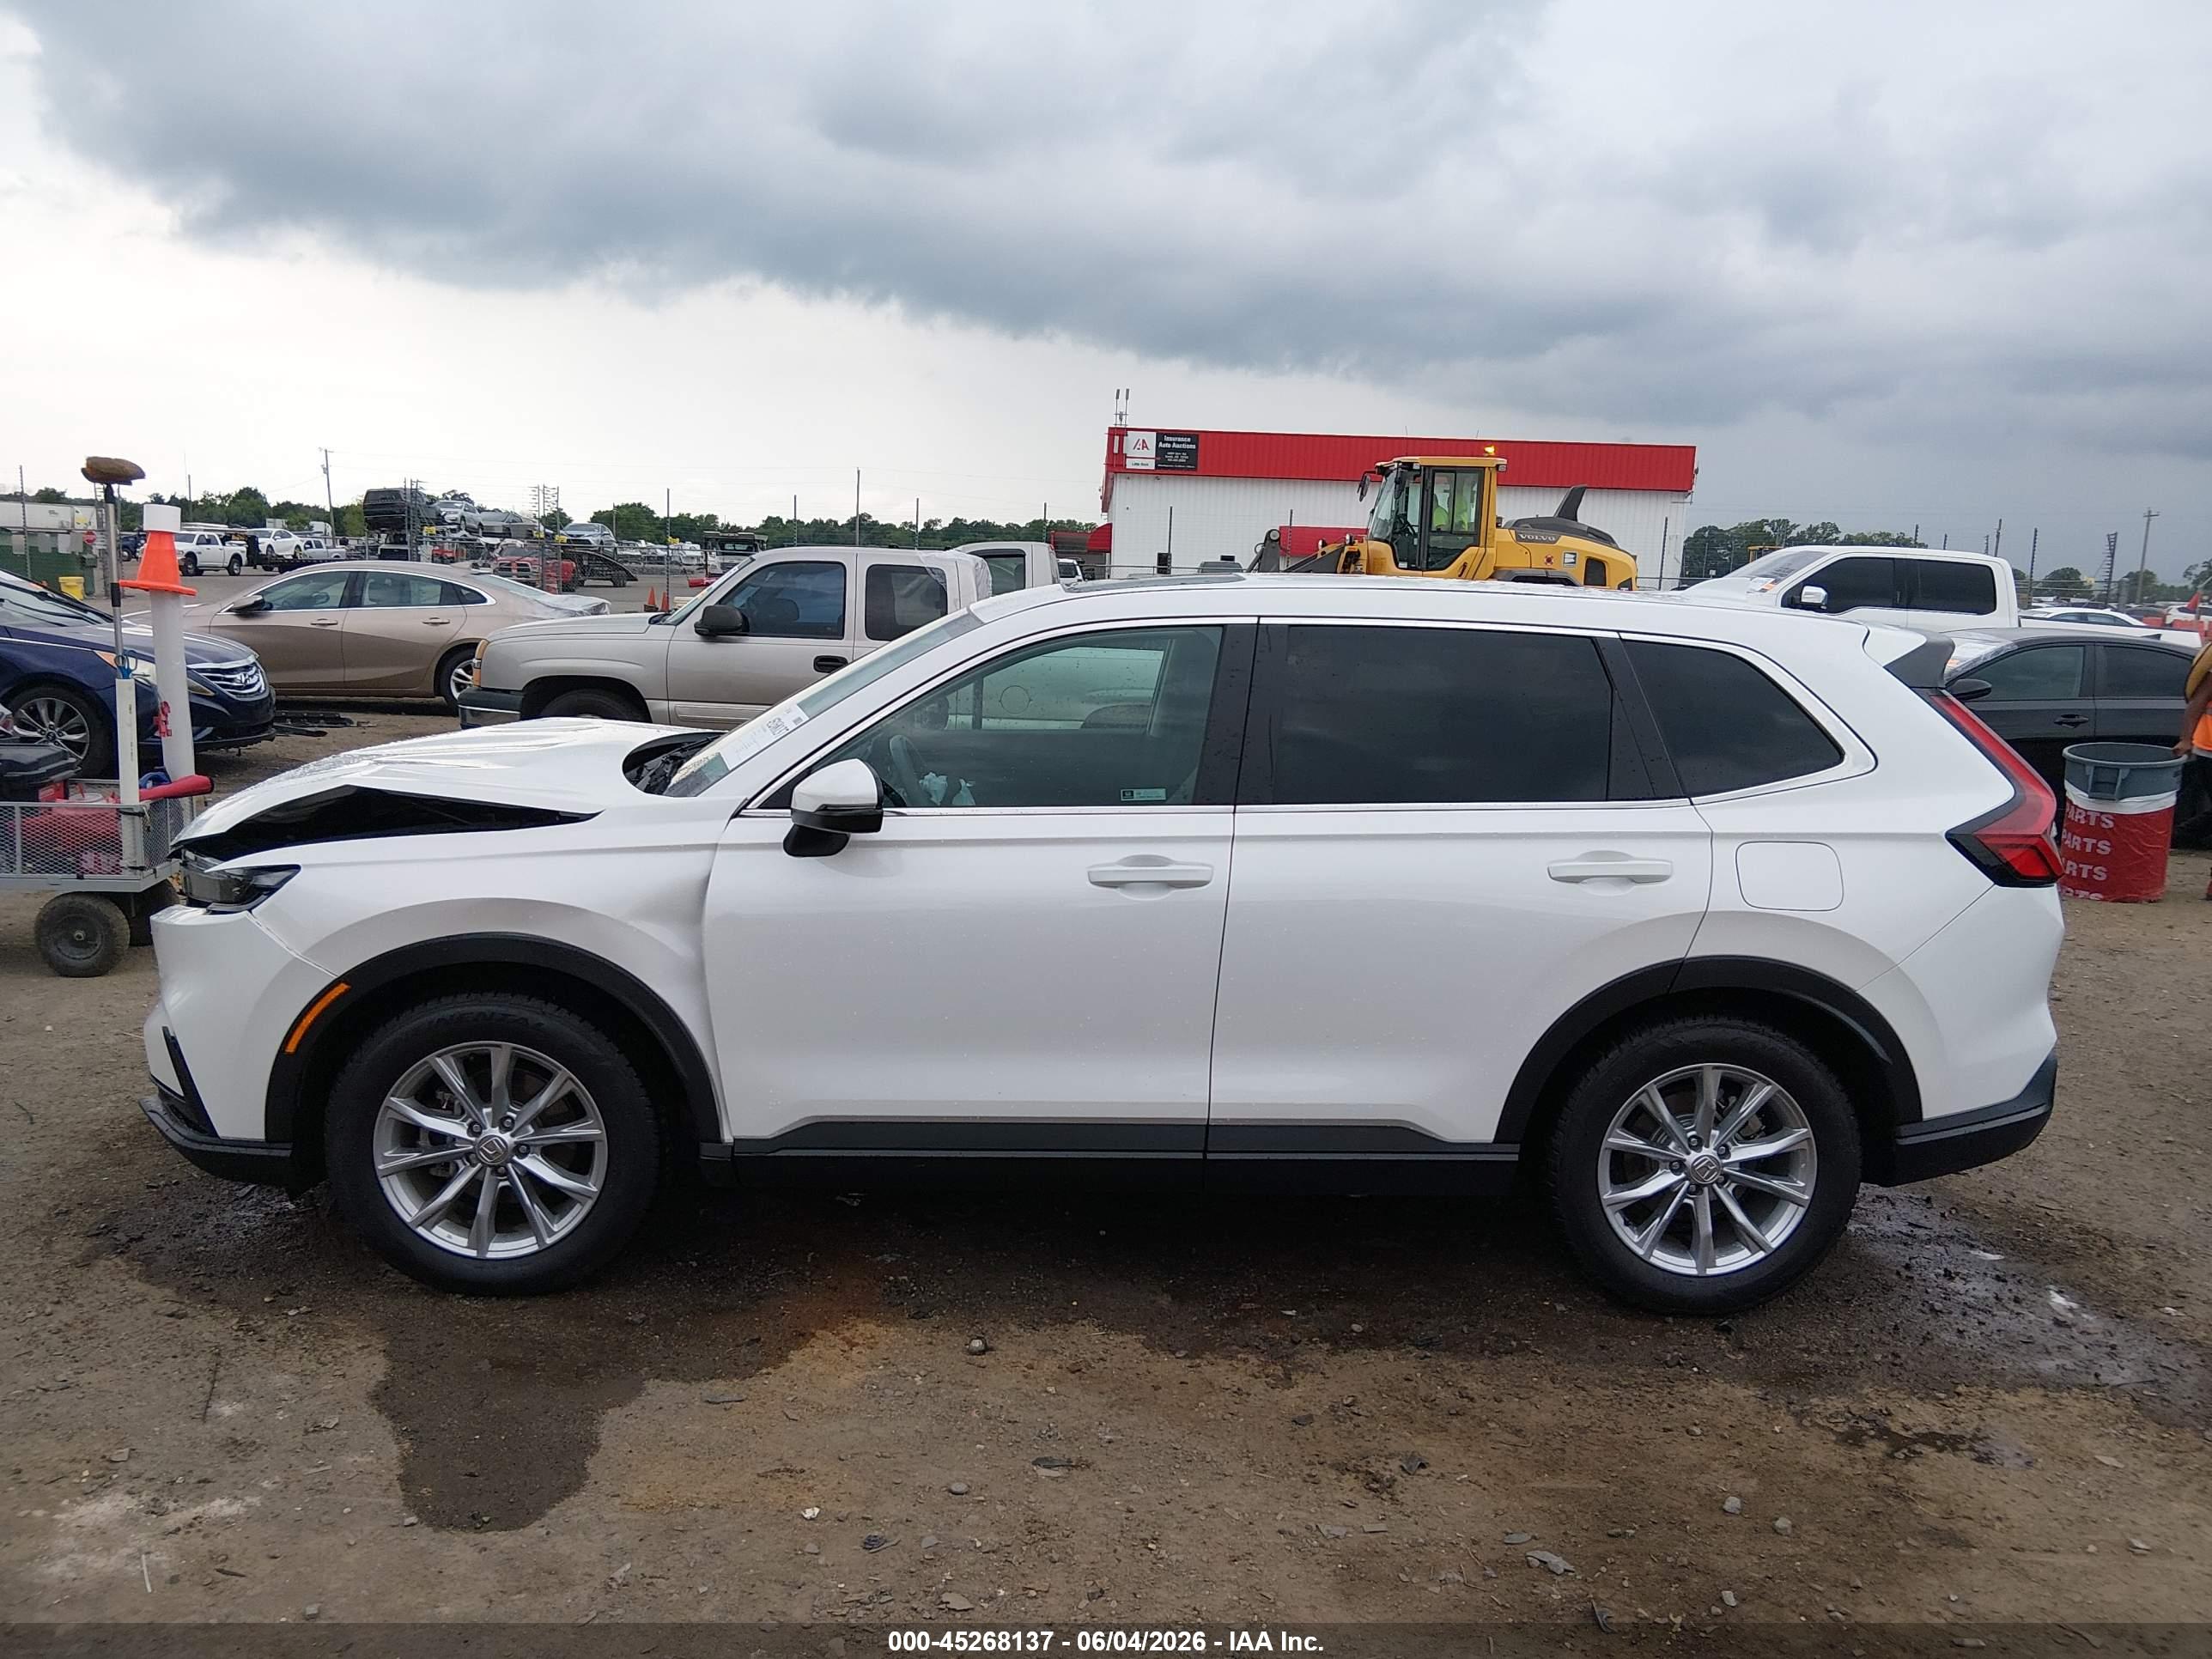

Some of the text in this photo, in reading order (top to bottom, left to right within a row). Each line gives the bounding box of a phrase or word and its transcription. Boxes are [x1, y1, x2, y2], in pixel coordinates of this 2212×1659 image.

[1172, 441, 1196, 450] Auctions
[1518, 533, 1556, 542] VOLVO
[2061, 828, 2112, 855] PARTS
